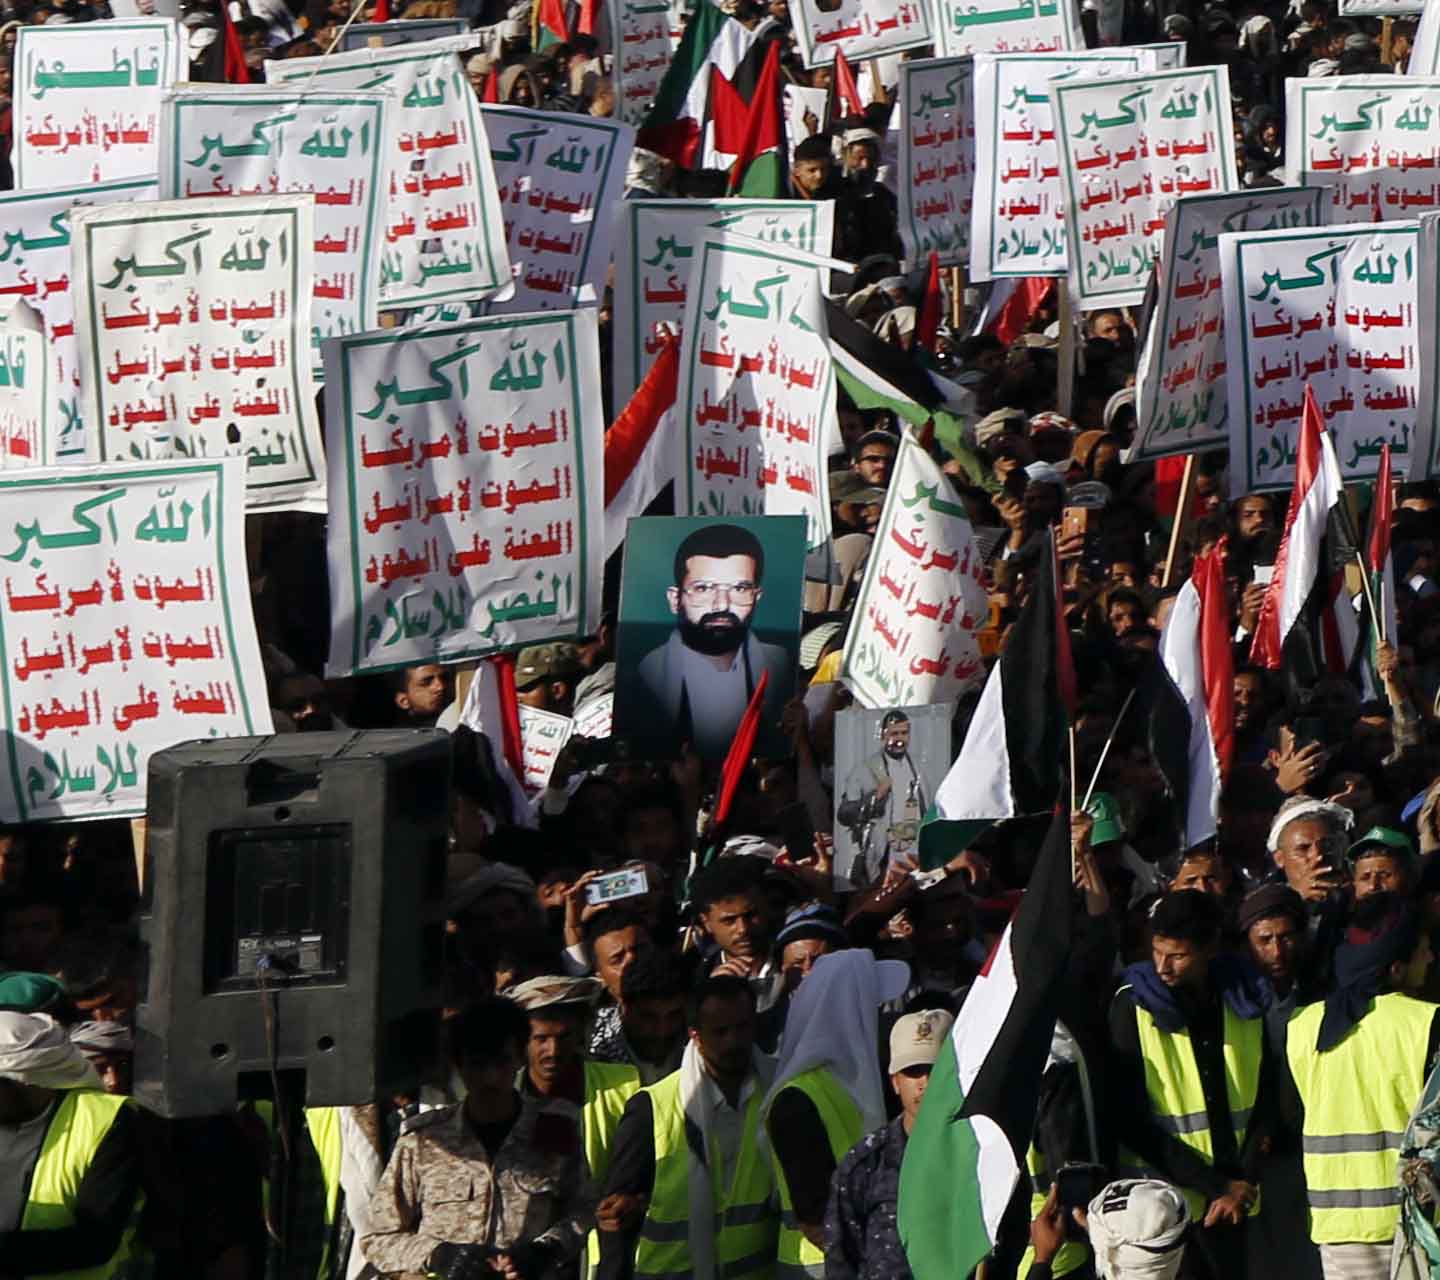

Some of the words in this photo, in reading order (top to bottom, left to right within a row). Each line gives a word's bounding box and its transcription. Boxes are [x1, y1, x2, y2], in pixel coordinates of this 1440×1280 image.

[489, 338, 565, 391] الله
[477, 408, 568, 458] الموت
[478, 464, 571, 514] الموت
[136, 486, 210, 544] الله
[503, 519, 572, 560] اللعنة
[364, 536, 439, 591] اليهود
[446, 532, 492, 578] على
[6, 560, 124, 618] لأمريكا
[134, 567, 214, 610] الموت
[480, 570, 572, 638] النصر
[15, 625, 132, 681] لإسرائيل
[143, 625, 224, 668] الموت
[19, 688, 101, 740] اليهود
[114, 683, 158, 731] على
[170, 680, 236, 714] اللعنة
